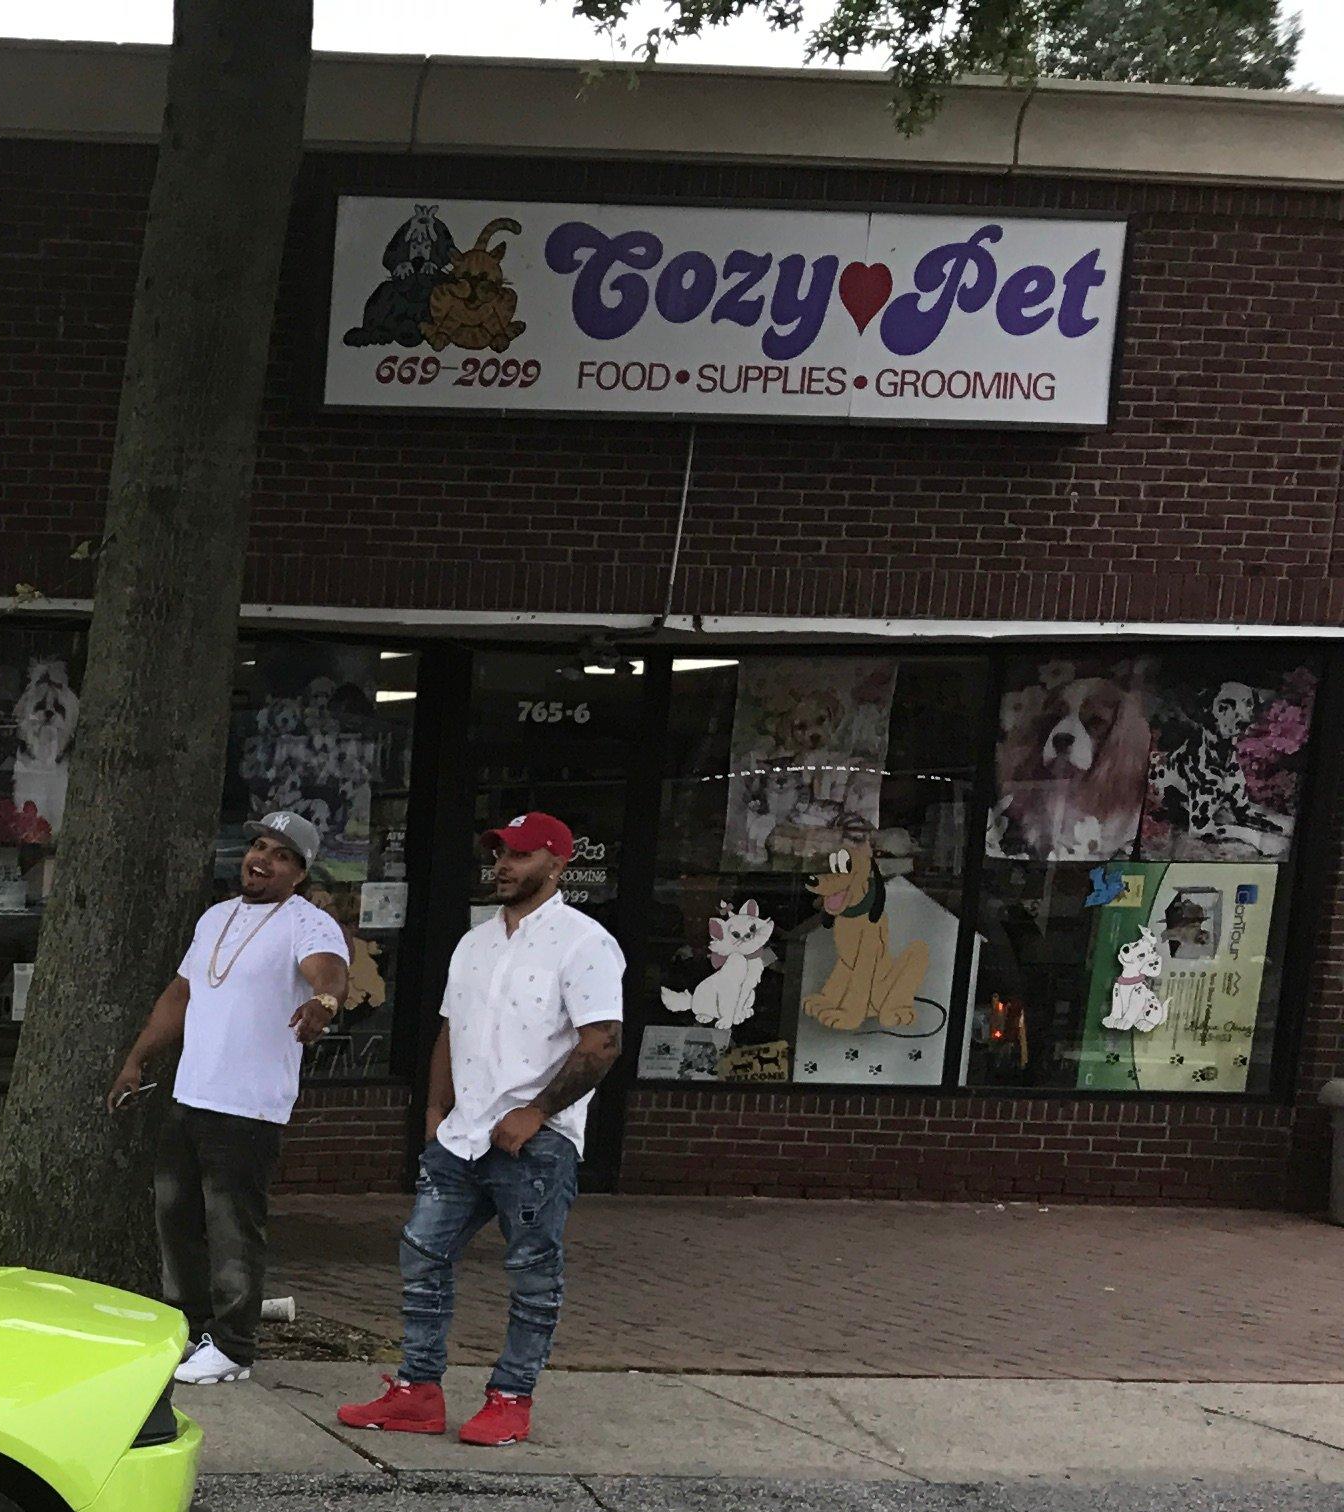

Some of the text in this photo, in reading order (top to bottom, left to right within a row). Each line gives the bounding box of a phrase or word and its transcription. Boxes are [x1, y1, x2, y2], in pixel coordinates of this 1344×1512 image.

[544, 220, 1107, 361] Cozy Pet
[375, 355, 1057, 402] 669-2099 FOOD SUPPLIES GROOMING
[517, 700, 591, 724] 765-6
